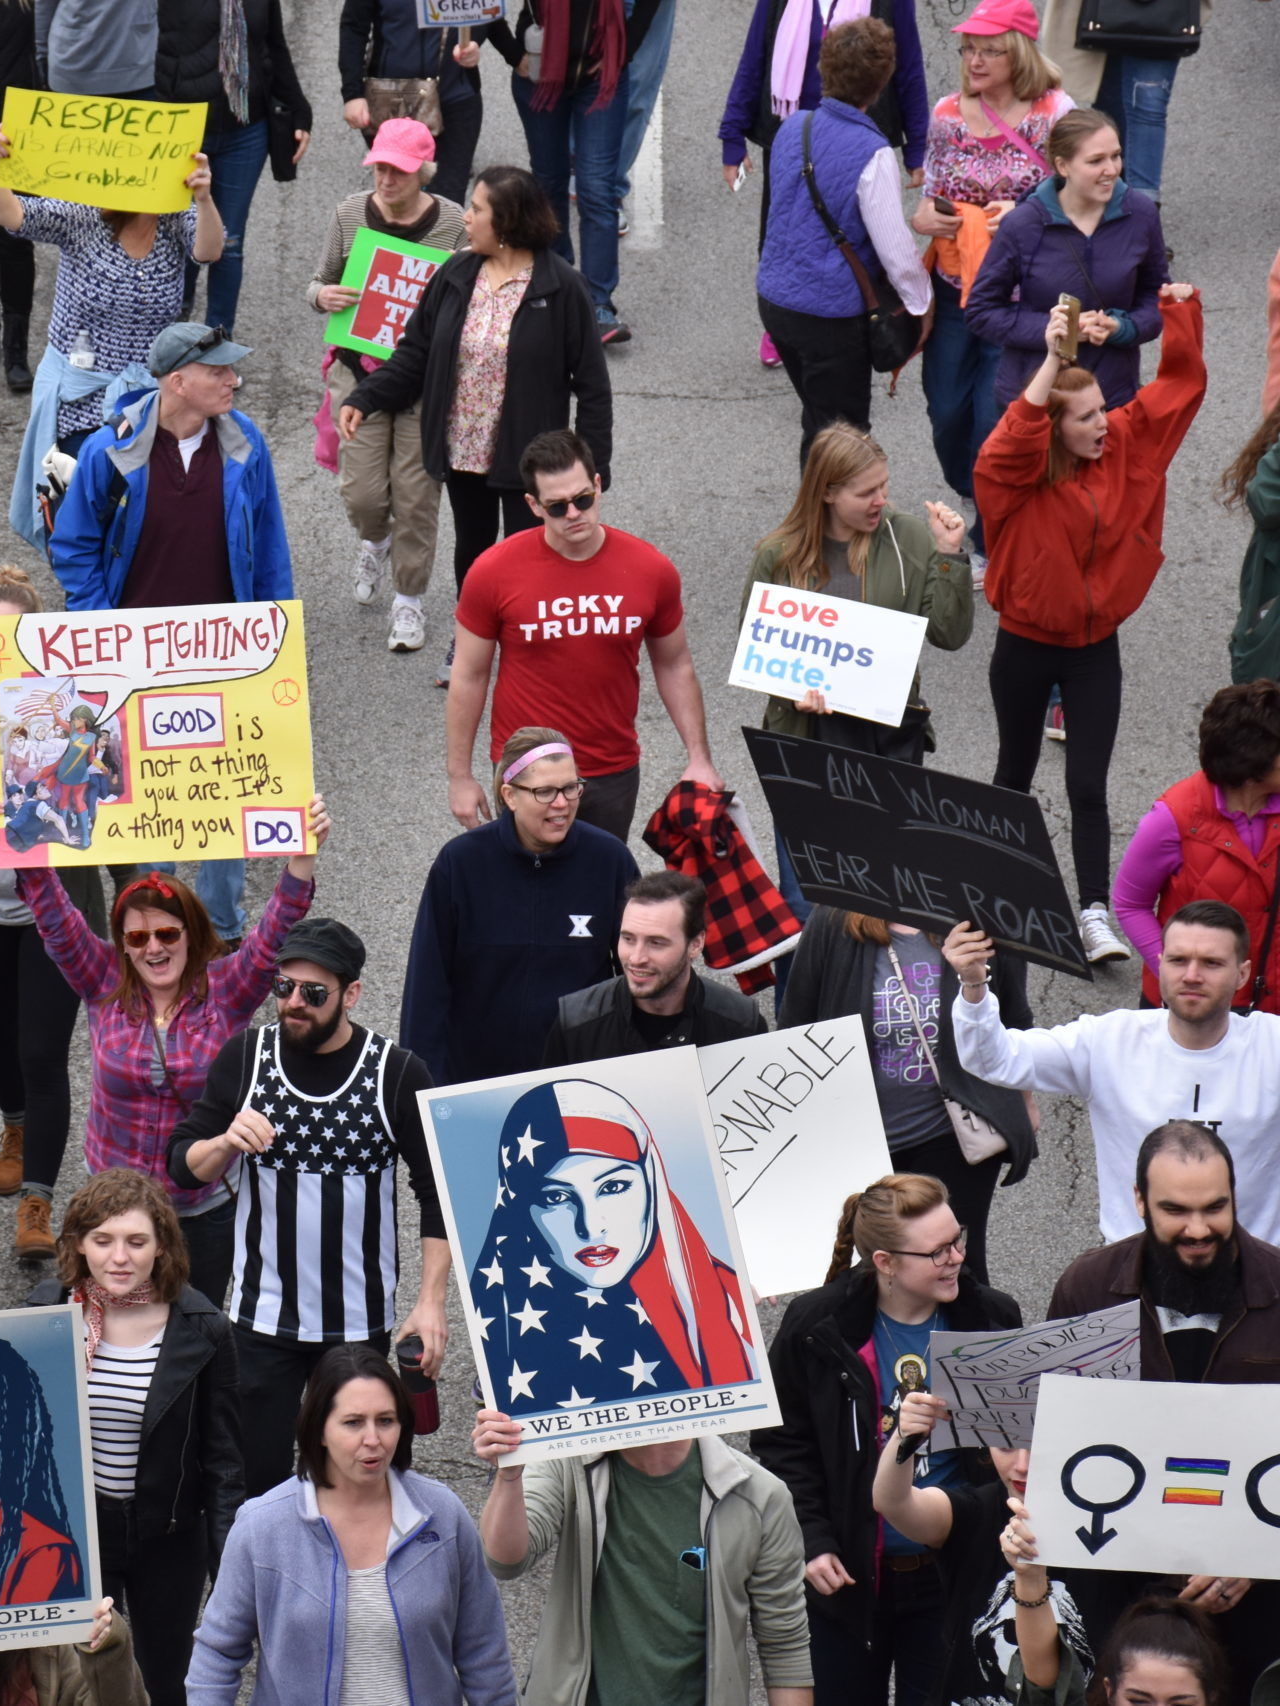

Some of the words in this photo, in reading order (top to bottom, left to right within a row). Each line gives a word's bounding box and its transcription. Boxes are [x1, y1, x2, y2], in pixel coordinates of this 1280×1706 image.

[29, 96, 190, 136] RESPECT
[54, 133, 143, 159] EARNED
[148, 140, 196, 161] NOT
[538, 595, 624, 619] ICKY
[758, 589, 839, 628] Love
[38, 623, 133, 671] KEEP
[142, 607, 281, 669] FIGHTING!
[519, 616, 642, 641] TRUMP
[750, 617, 874, 667] trumps
[742, 644, 832, 691] hate.
[152, 708, 216, 736] GOOD
[236, 713, 264, 741] is
[140, 754, 181, 779] not
[189, 755, 206, 773] a
[212, 749, 270, 784] thing
[144, 784, 179, 820] you
[188, 782, 229, 801] are.
[232, 775, 283, 798] It's
[755, 736, 821, 789] I
[826, 753, 882, 804] AM
[889, 771, 1026, 846] WOMAN
[107, 823, 122, 839] a
[127, 813, 184, 850] thing
[192, 815, 235, 849] you
[254, 820, 299, 846] DO.
[785, 837, 890, 898] HEAR
[892, 864, 956, 915] ME
[960, 882, 1088, 965] ROAR
[713, 1024, 855, 1175] RNABLE
[1193, 1084, 1201, 1113] I
[954, 1357, 1020, 1377] OUR
[1010, 1318, 1106, 1364] BODIES
[528, 1414, 573, 1435] WE
[578, 1406, 630, 1428] THE
[637, 1391, 736, 1419] PEOPLE
[955, 1409, 1020, 1425] OUR
[547, 1440, 574, 1451] ARE
[580, 1429, 641, 1447] GREATER
[647, 1424, 685, 1436] THAN
[692, 1418, 727, 1430] FEAR
